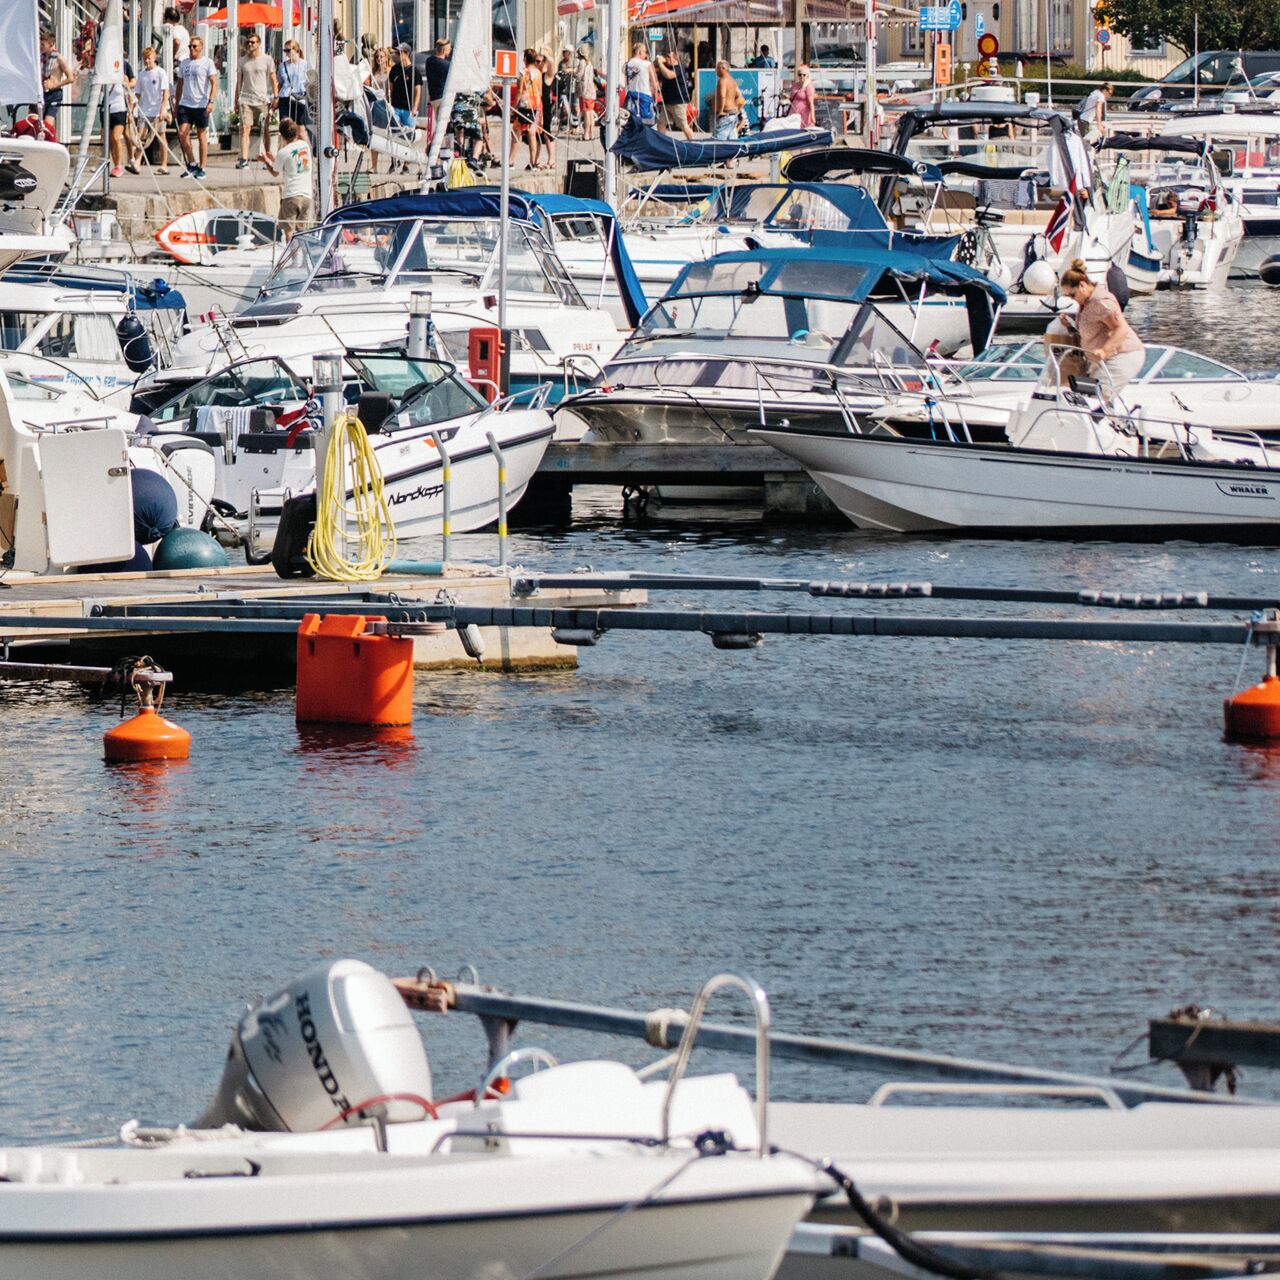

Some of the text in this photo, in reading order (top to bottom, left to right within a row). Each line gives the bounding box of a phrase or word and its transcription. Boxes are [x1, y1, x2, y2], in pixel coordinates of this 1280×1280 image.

[186, 465, 194, 525] EVINRDE
[1230, 486, 1268, 495] WHALER
[295, 988, 367, 1124] HONDA
